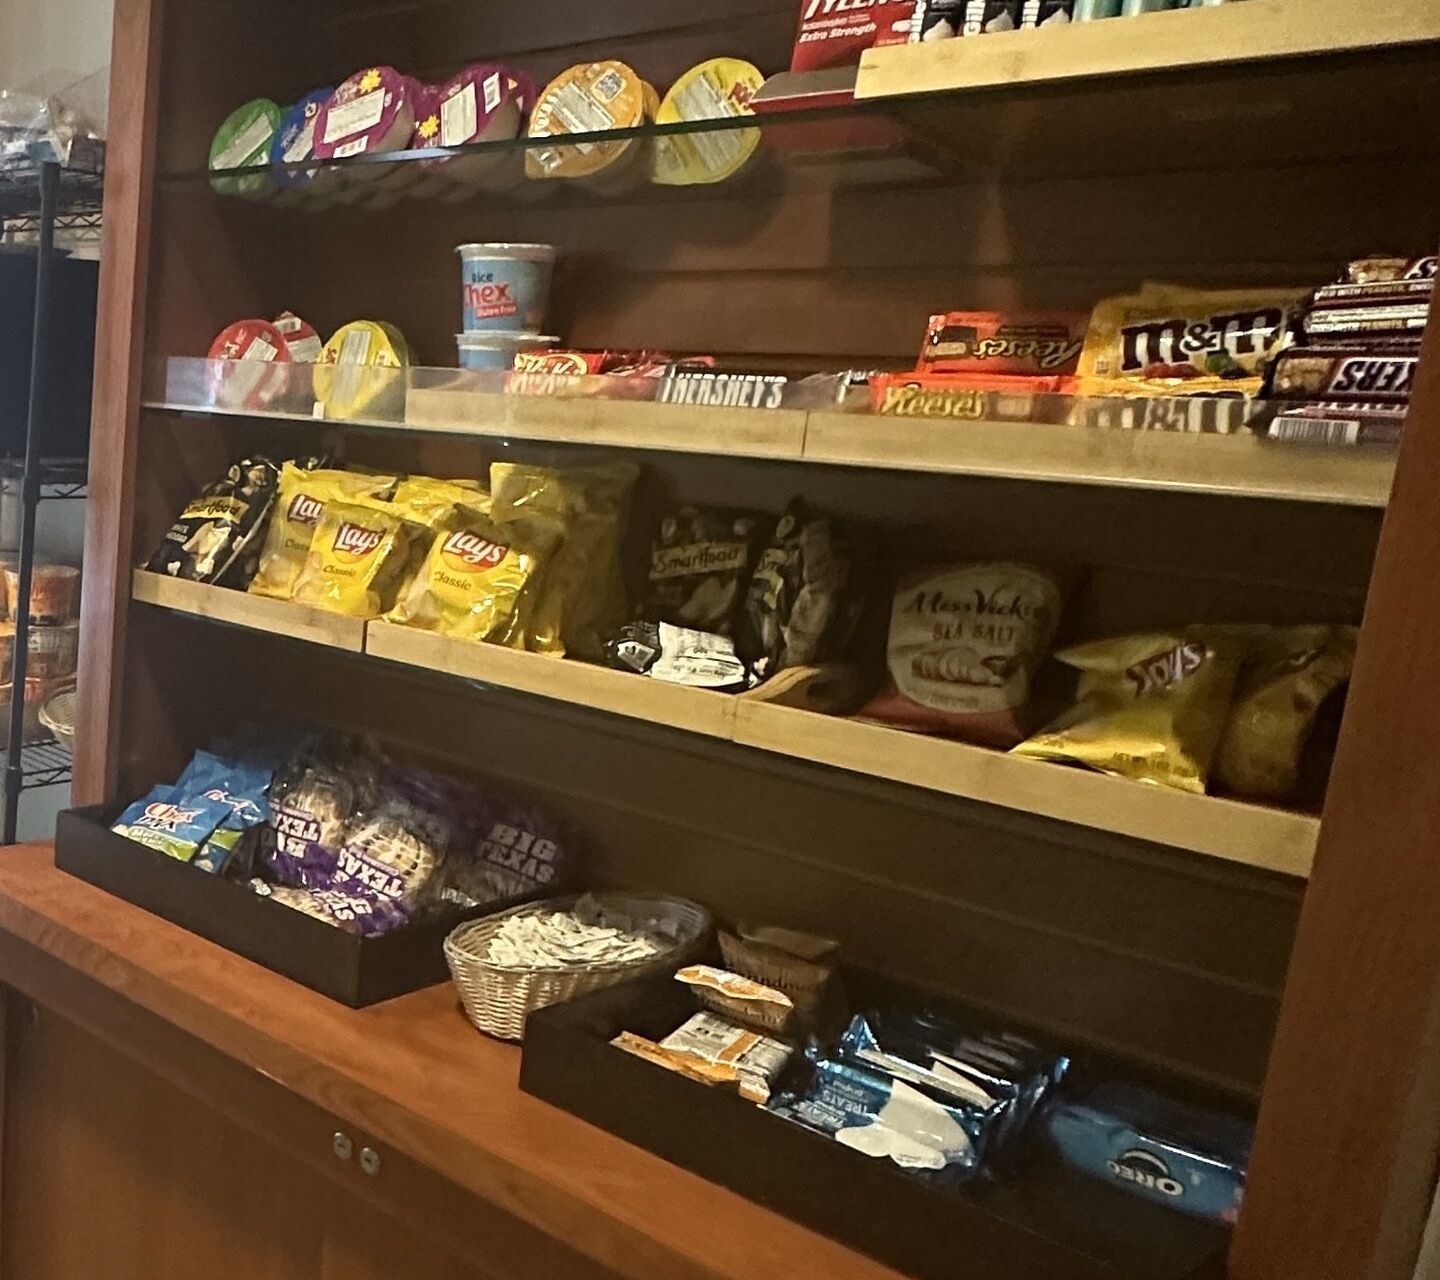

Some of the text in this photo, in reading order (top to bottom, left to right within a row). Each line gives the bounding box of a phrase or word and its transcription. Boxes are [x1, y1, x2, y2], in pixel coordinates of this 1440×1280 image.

[799, 31, 829, 43] Extra
[828, 22, 877, 39] Strength
[491, 823, 559, 862] BIG
[1106, 1158, 1185, 1197] OREO
